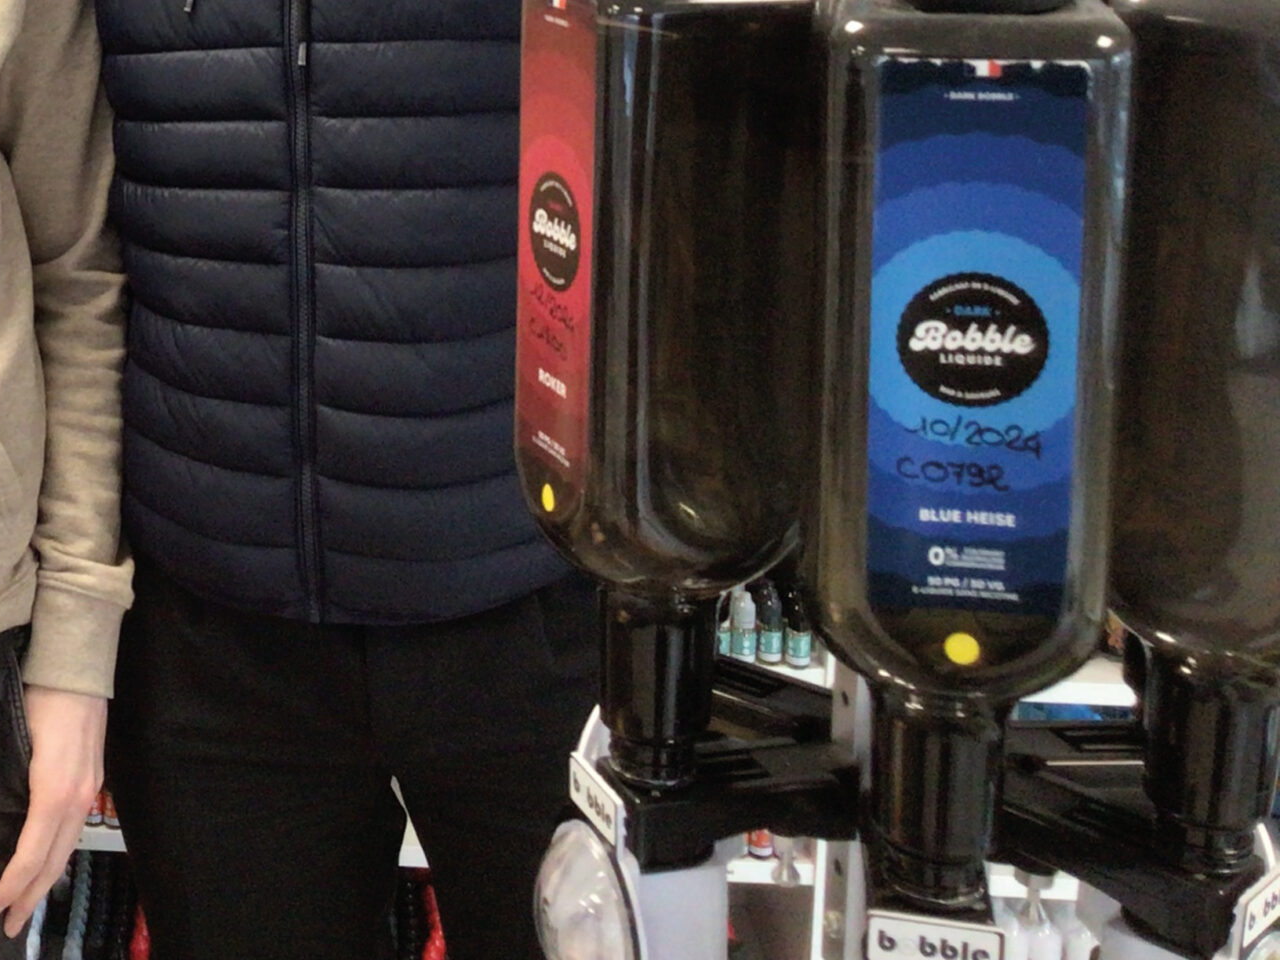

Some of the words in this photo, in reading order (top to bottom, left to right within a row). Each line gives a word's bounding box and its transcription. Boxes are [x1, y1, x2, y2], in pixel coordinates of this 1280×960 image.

[532, 207, 577, 251] Bobble
[908, 319, 1037, 356] Bobble
[939, 353, 1005, 367] LIQUIDE
[918, 507, 963, 523] BLUE
[966, 509, 1017, 528] HEISE
[572, 773, 614, 831] bbble
[877, 929, 991, 960] bbble
